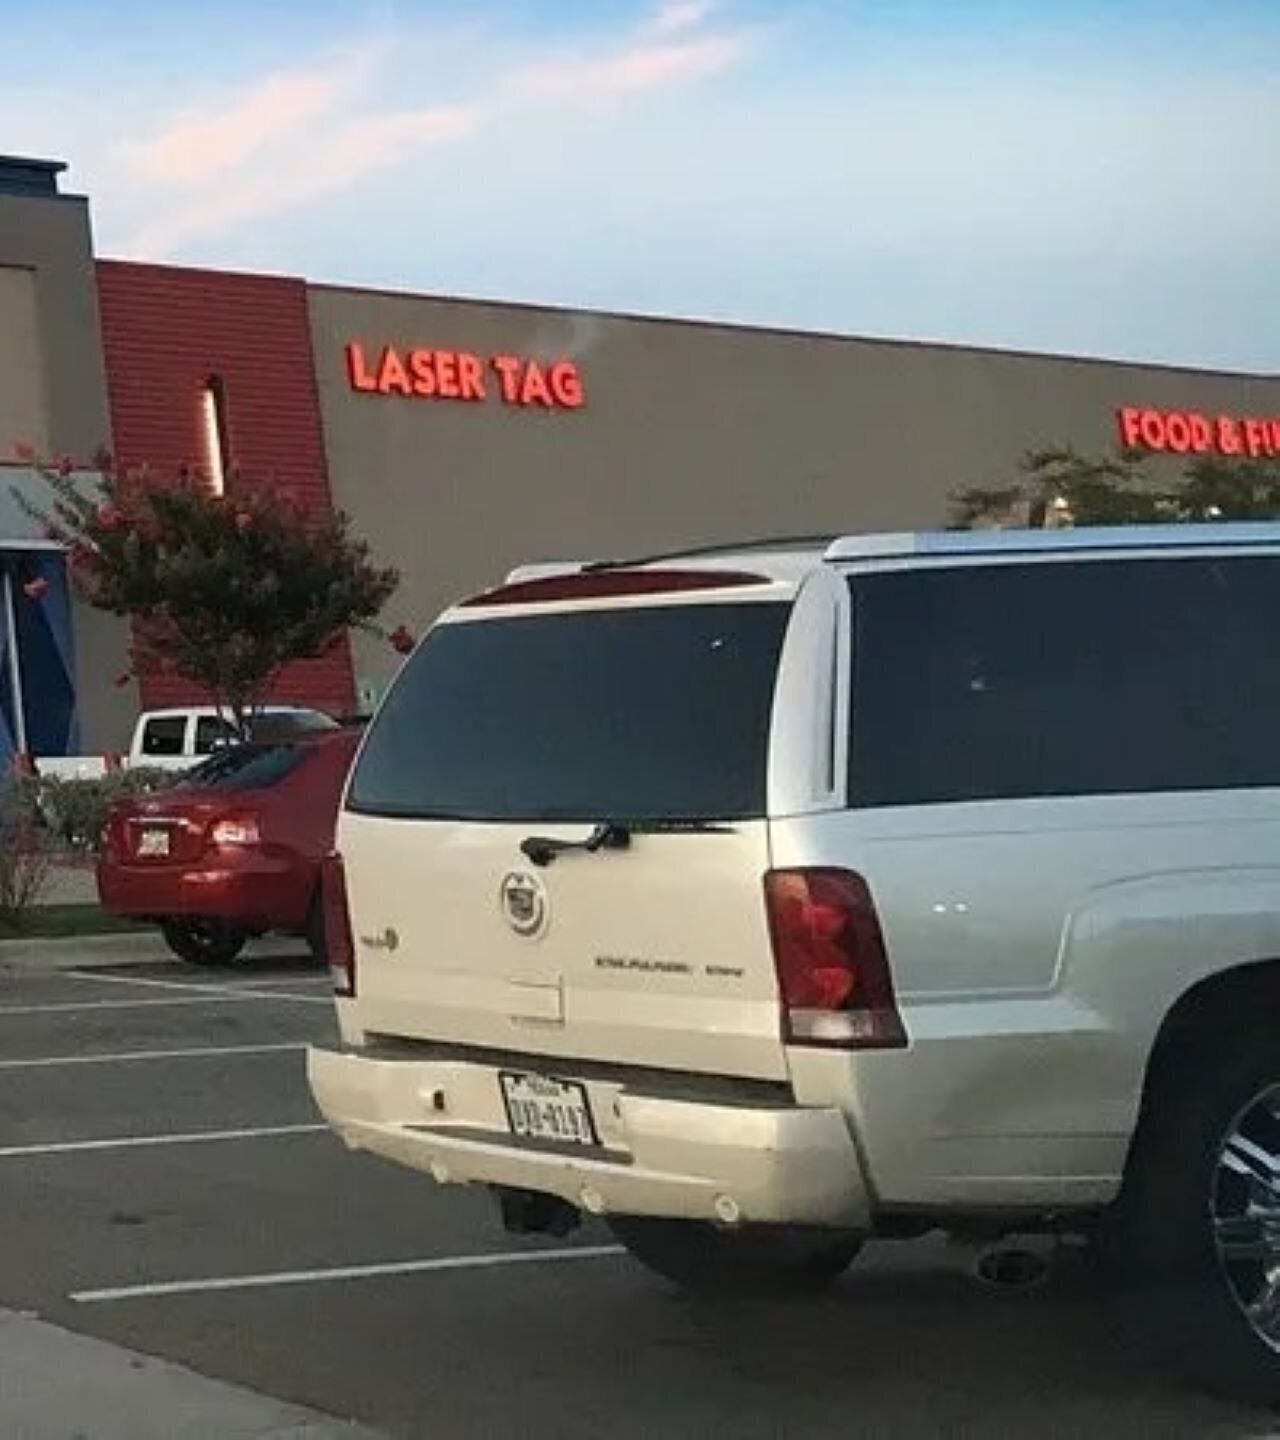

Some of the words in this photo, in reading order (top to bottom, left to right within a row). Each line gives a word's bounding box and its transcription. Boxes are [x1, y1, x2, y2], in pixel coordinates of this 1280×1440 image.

[347, 341, 486, 401] LASER
[492, 356, 584, 408] TAG
[1120, 408, 1210, 452] FOOD
[1218, 415, 1241, 455] &
